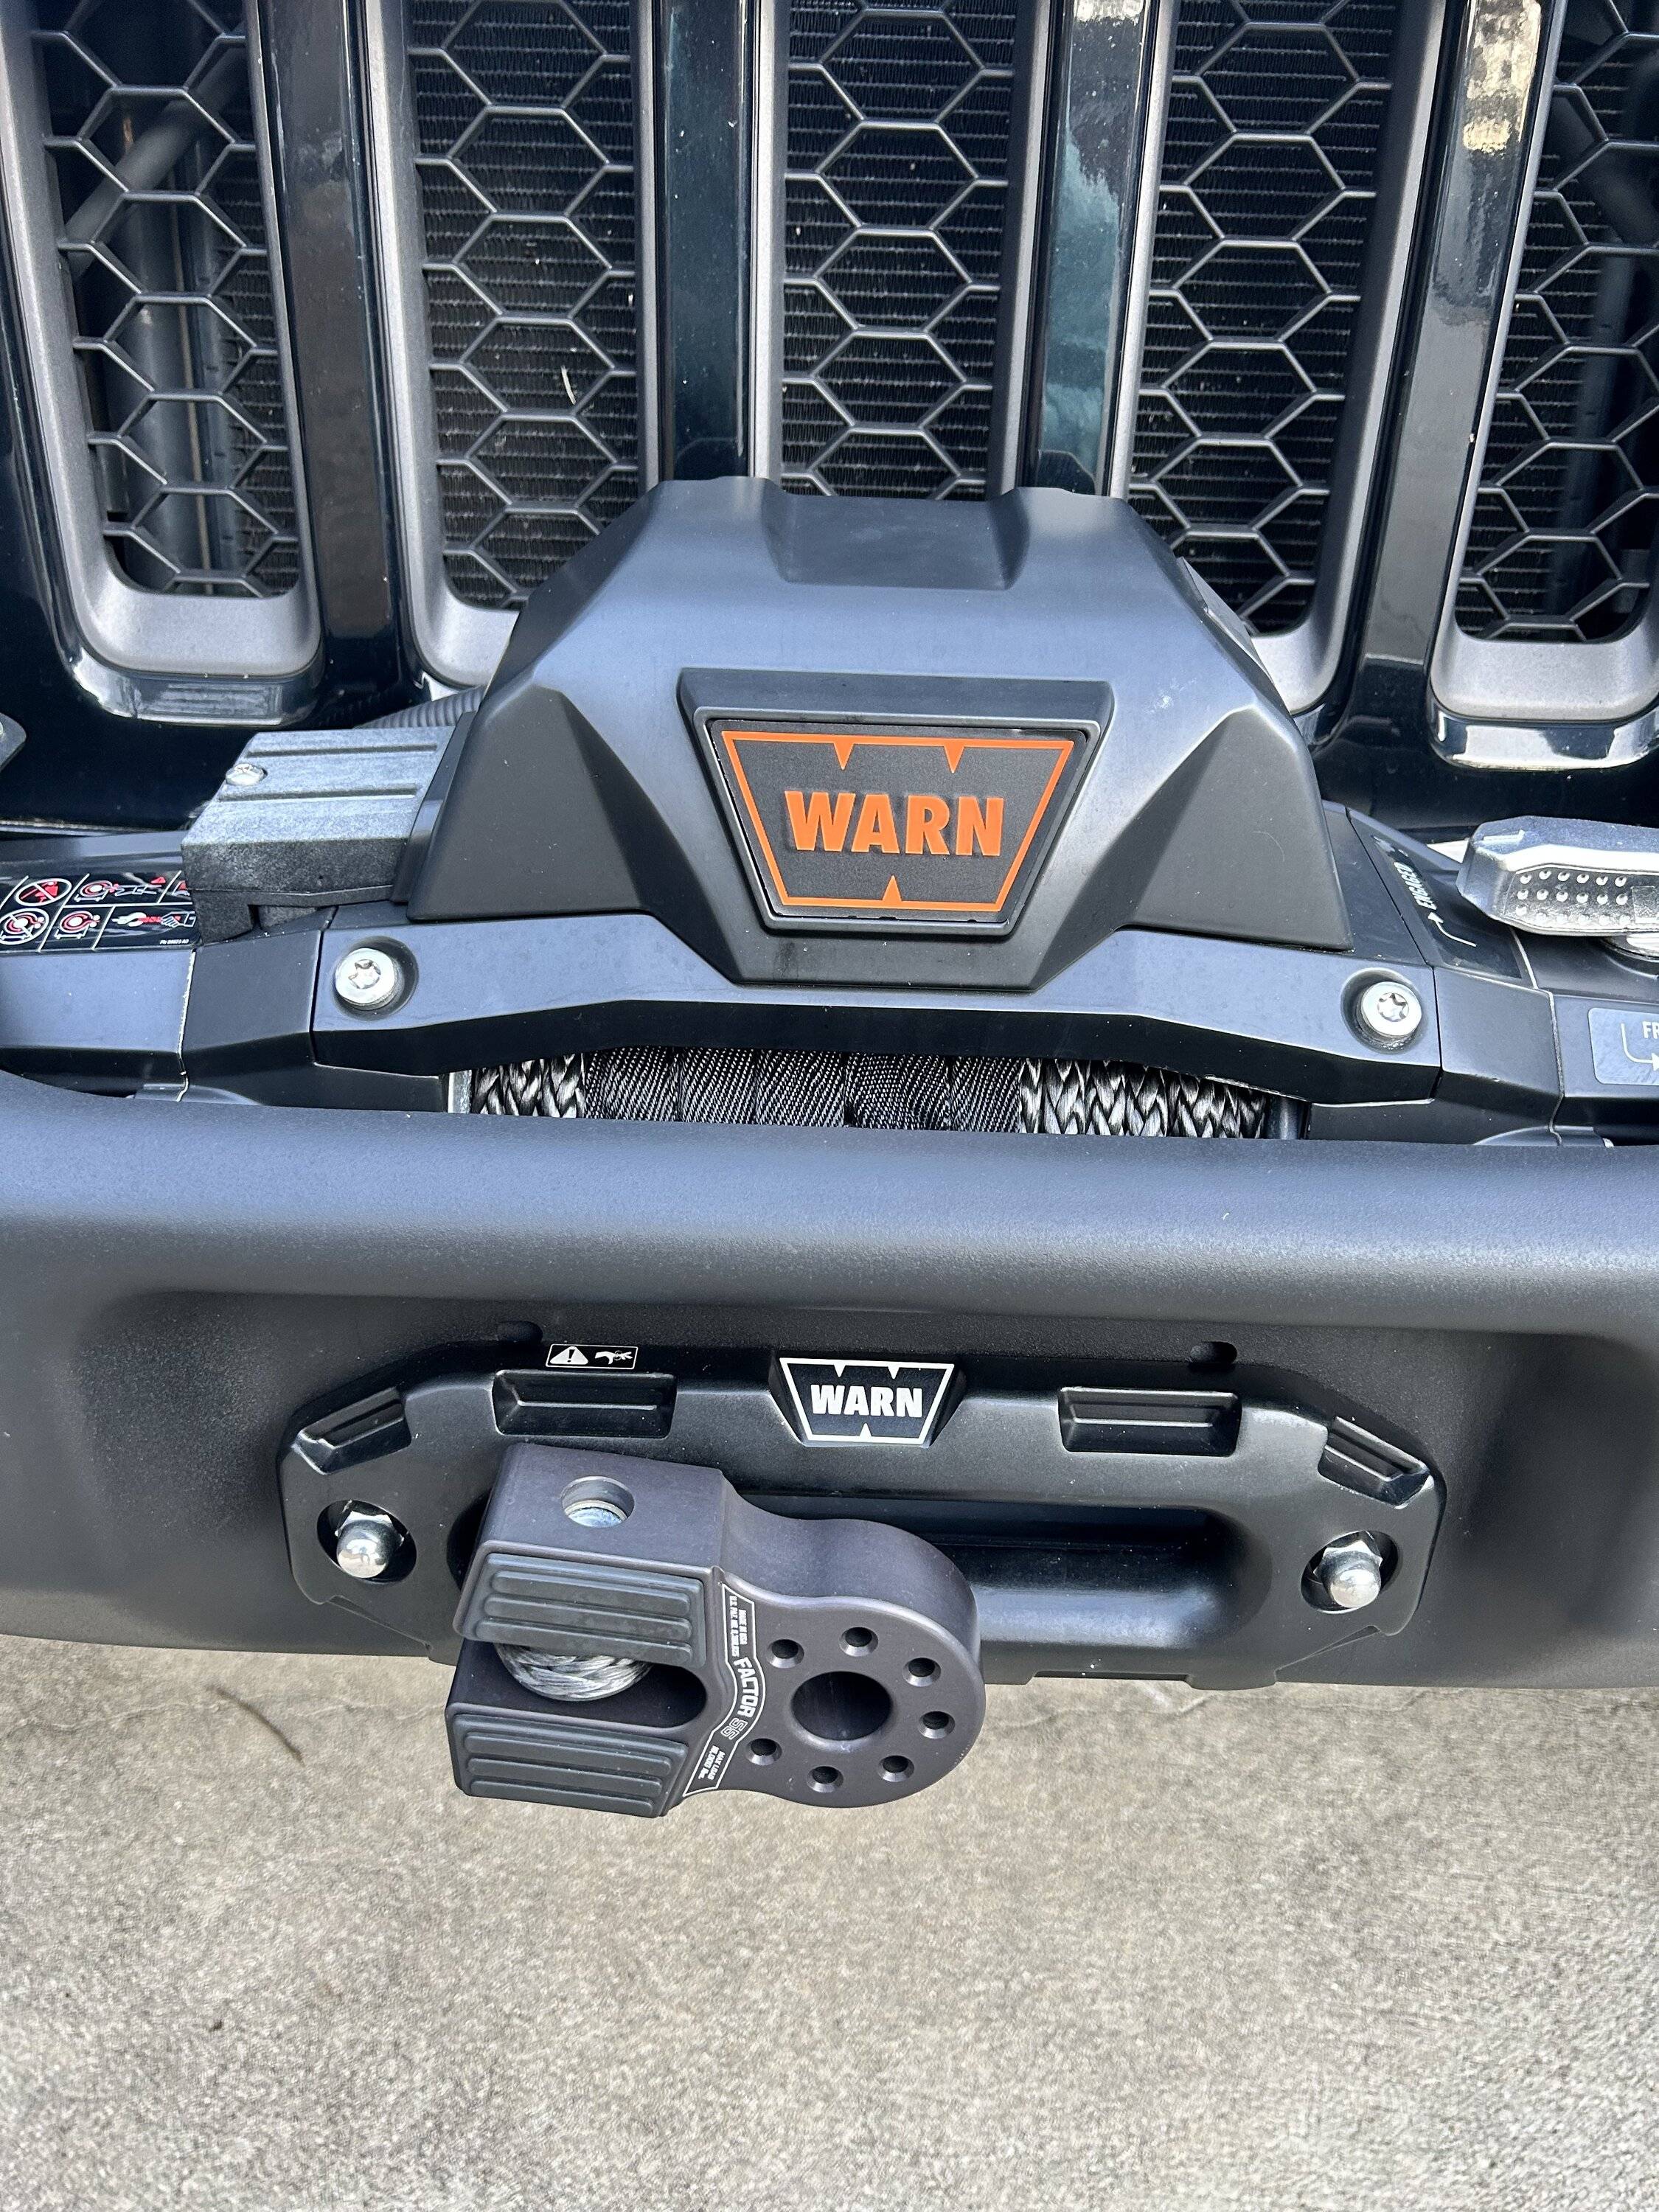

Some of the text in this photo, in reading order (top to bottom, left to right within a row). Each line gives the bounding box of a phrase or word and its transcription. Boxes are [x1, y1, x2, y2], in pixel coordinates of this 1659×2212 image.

[784, 790, 1004, 857] WARN
[1394, 862, 1437, 910] ENGAGED
[811, 1385, 923, 1418] WARN
[721, 1658, 759, 1740] FACTOR 55
